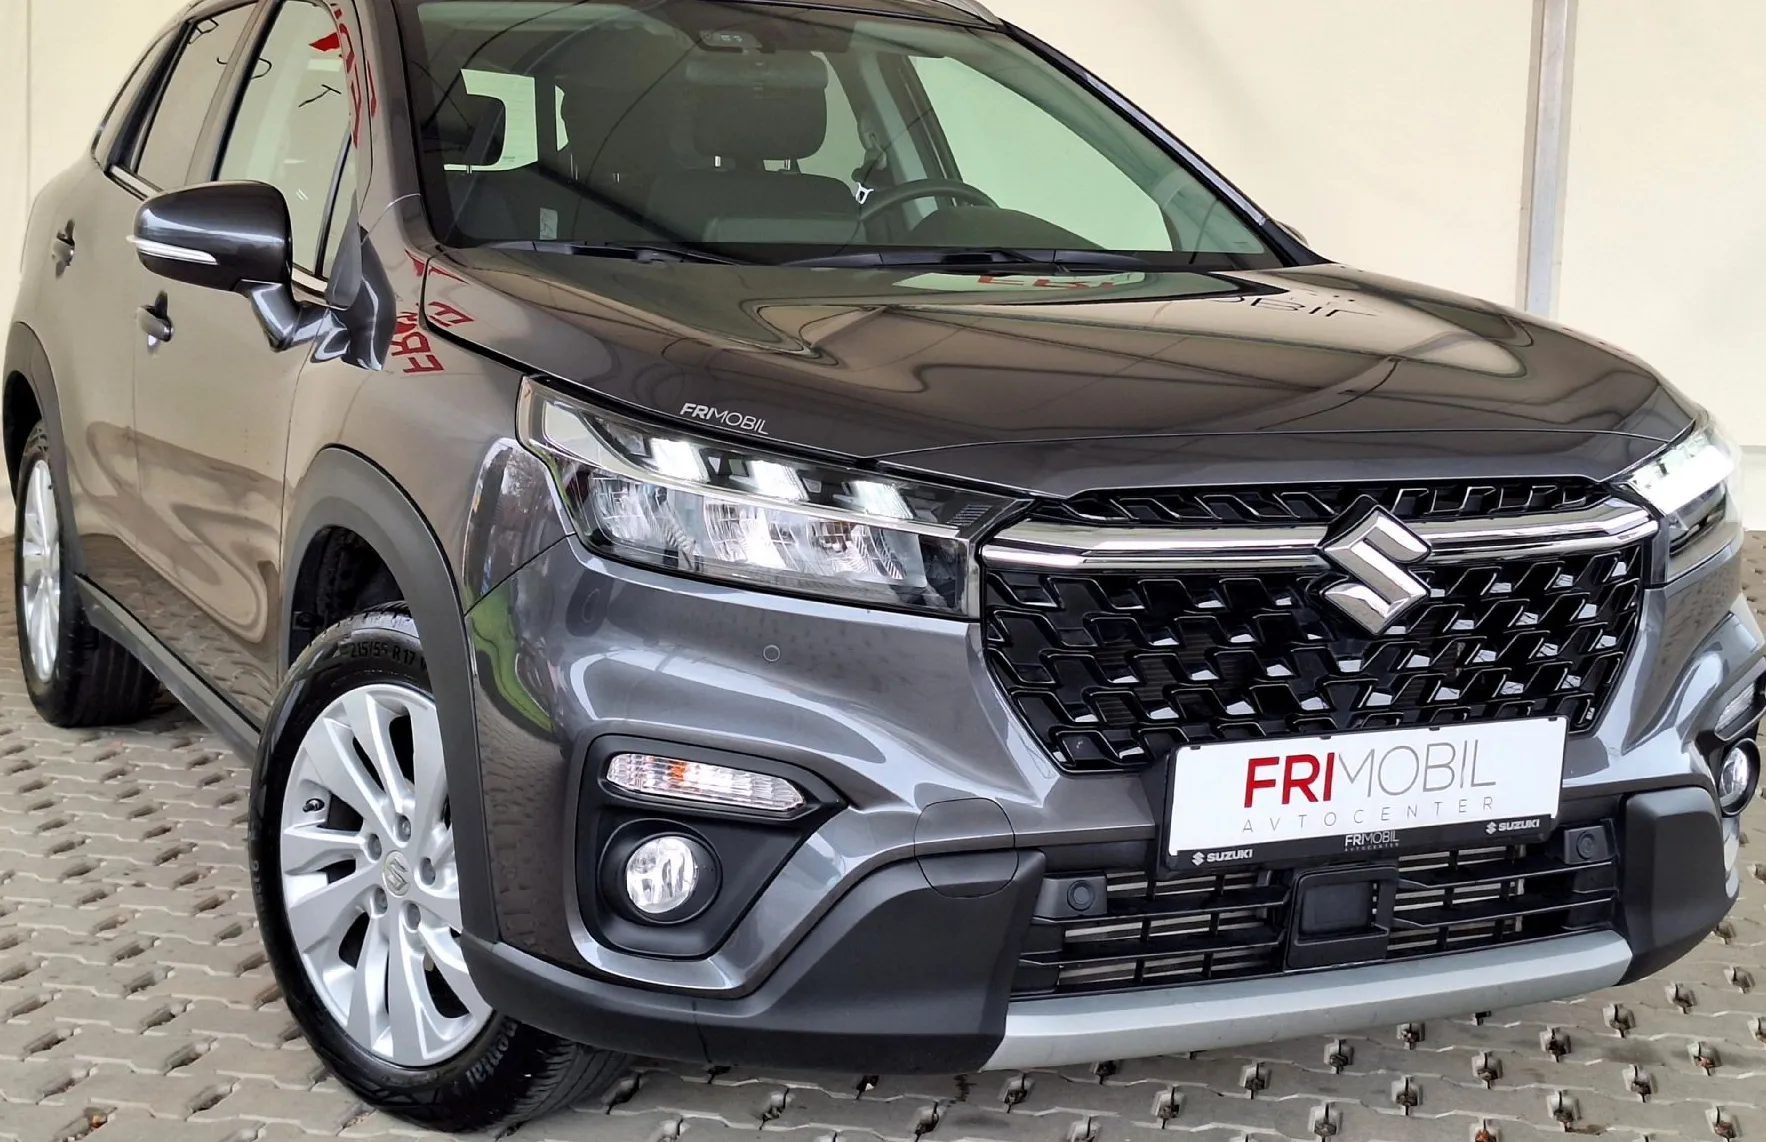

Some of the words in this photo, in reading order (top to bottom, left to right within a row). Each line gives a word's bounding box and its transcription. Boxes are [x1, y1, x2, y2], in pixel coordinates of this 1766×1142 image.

[680, 402, 769, 435] FRIMOBIL
[1244, 739, 1497, 809] FRIMOBIL
[1242, 796, 1494, 834] AVTOCENTER
[1497, 819, 1540, 832] SUZUKI
[1345, 830, 1399, 847] FRIMOBIL
[1206, 849, 1253, 863] SUZUKI
